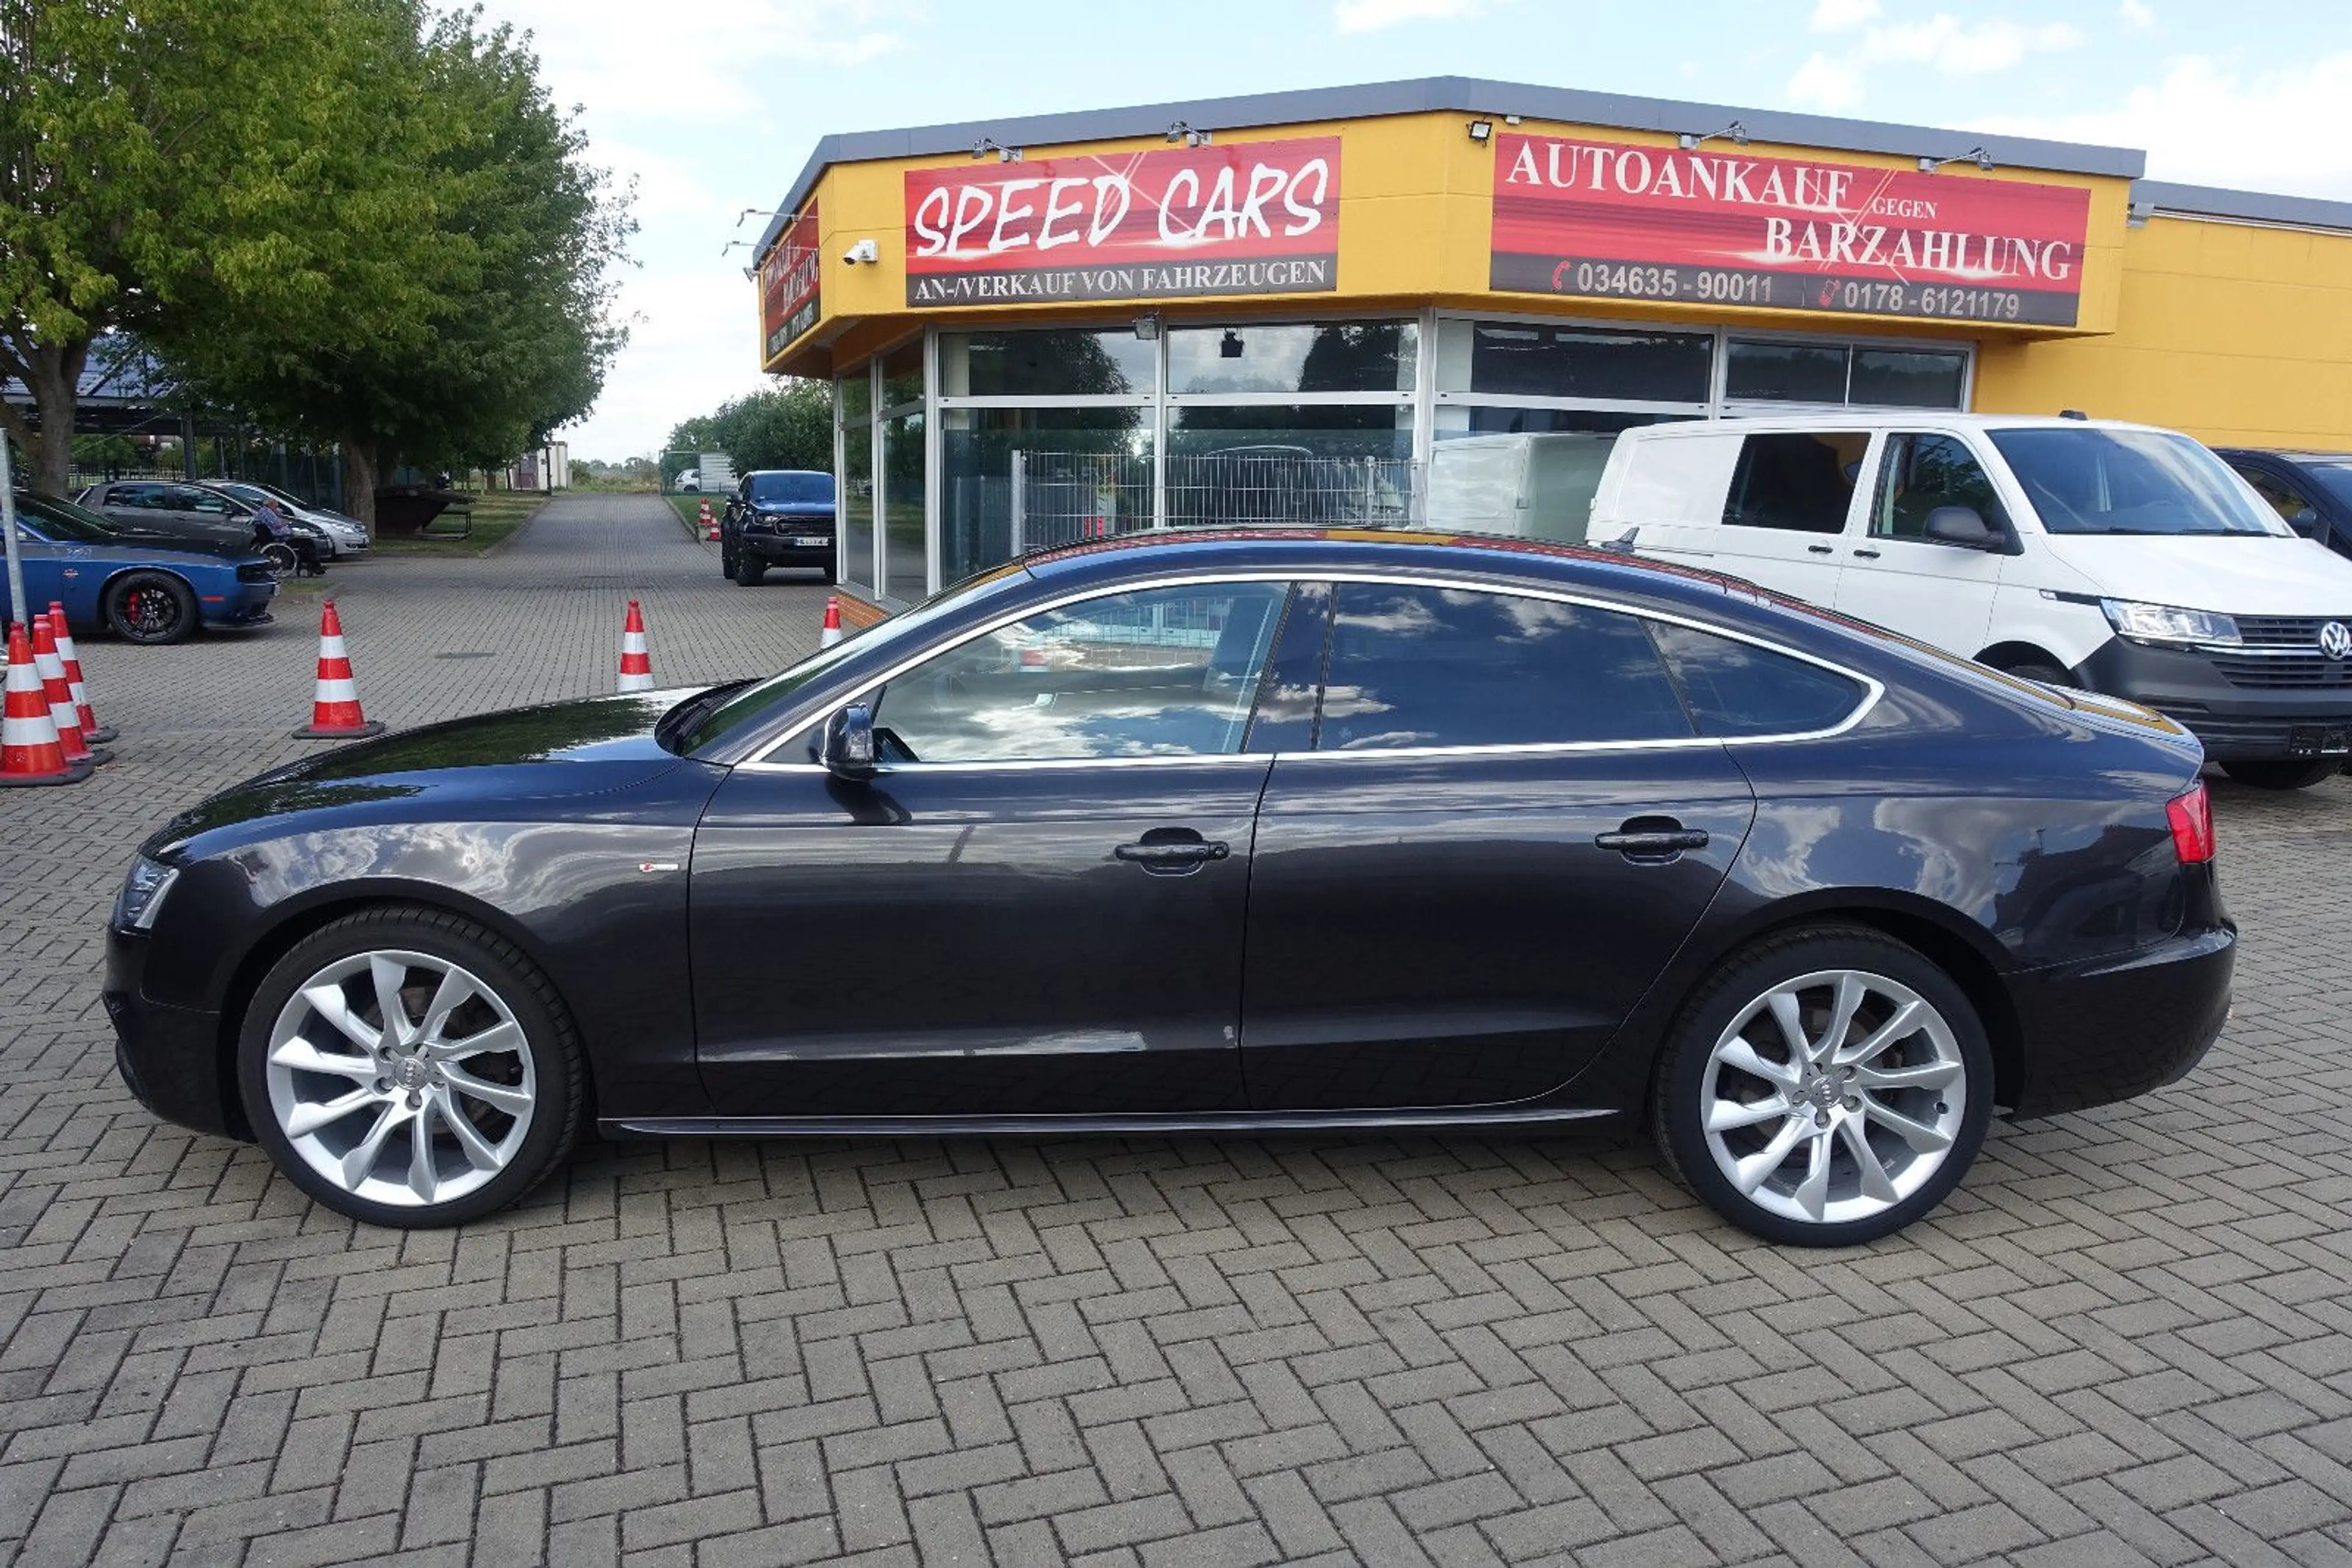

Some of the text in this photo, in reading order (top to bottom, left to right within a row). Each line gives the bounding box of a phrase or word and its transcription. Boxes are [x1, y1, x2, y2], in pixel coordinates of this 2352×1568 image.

[914, 158, 1329, 257] SPEED CARS
[1506, 139, 1938, 220] AUTOANKAUF GEGEN
[1080, 270, 1133, 293] VON
[1141, 260, 1327, 291] FAHRZEUGEN
[1765, 217, 2071, 280] BARZAHLUNG
